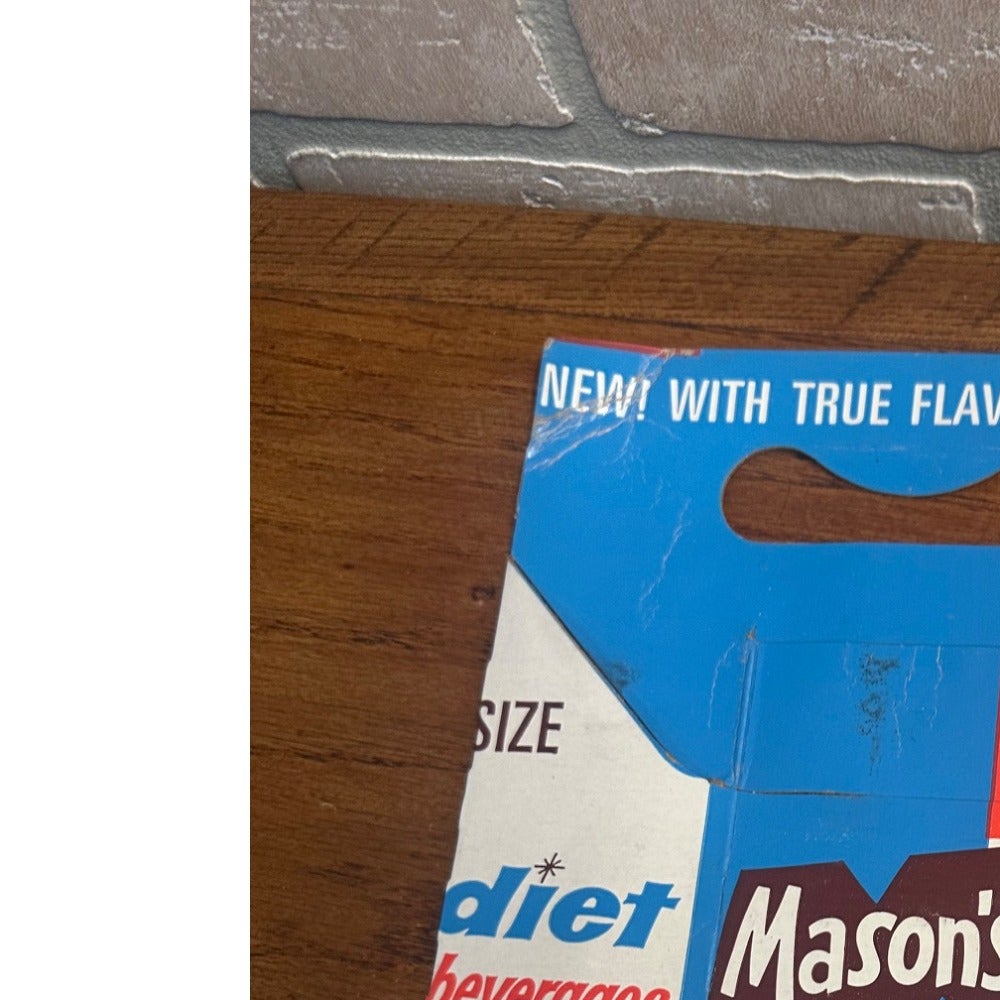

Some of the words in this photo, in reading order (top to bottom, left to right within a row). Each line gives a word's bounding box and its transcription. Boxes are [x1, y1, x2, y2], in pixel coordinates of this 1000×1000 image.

[540, 363, 651, 421] NEW!
[670, 379, 771, 424] WITH
[792, 382, 893, 426] TRUE
[473, 700, 564, 754] SIZE
[440, 853, 682, 949] diet
